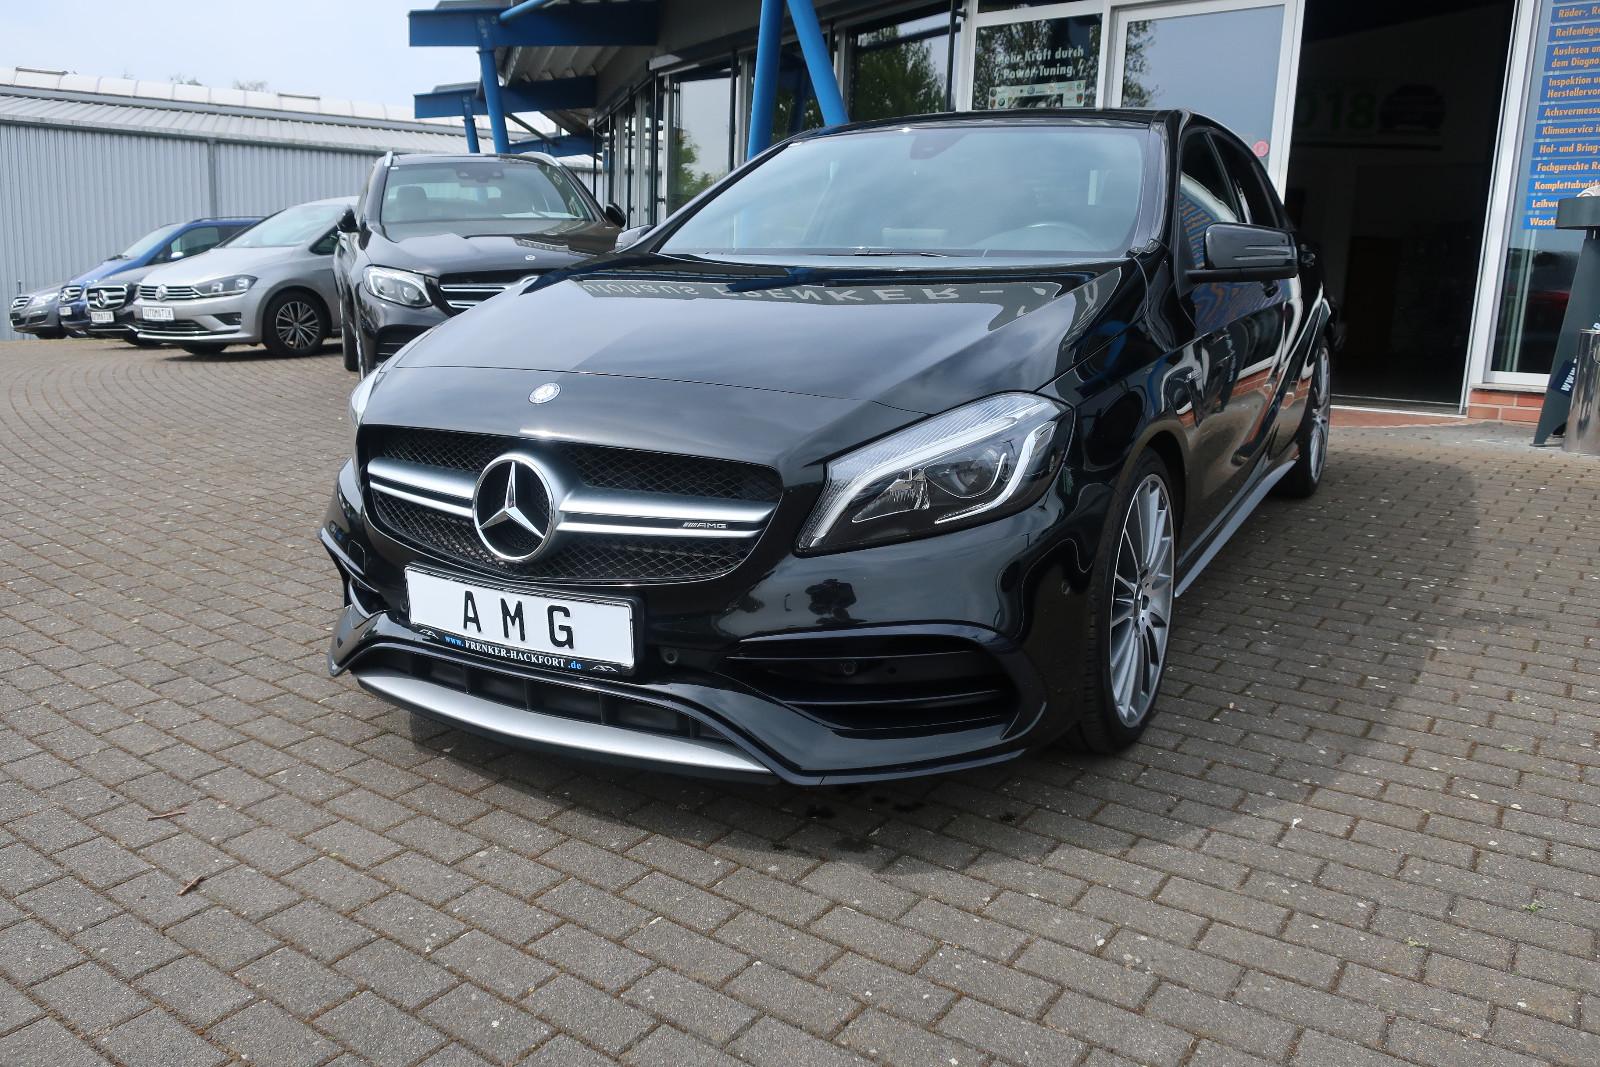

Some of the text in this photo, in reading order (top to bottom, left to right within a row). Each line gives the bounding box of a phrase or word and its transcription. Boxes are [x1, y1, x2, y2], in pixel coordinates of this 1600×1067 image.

[1025, 47, 1051, 62] Kraft
[1055, 45, 1084, 60] durch
[1553, 45, 1590, 57] Auslesen
[1551, 56, 1600, 68] dem Diagno
[1548, 76, 1592, 88] Inspektion
[1542, 124, 1593, 135] Klimaservice
[1539, 144, 1557, 154] Hol-
[1559, 144, 1574, 153] und
[1536, 161, 1589, 174] Fachgerechte
[464, 638, 566, 668] FRENKER-HACKFORT
